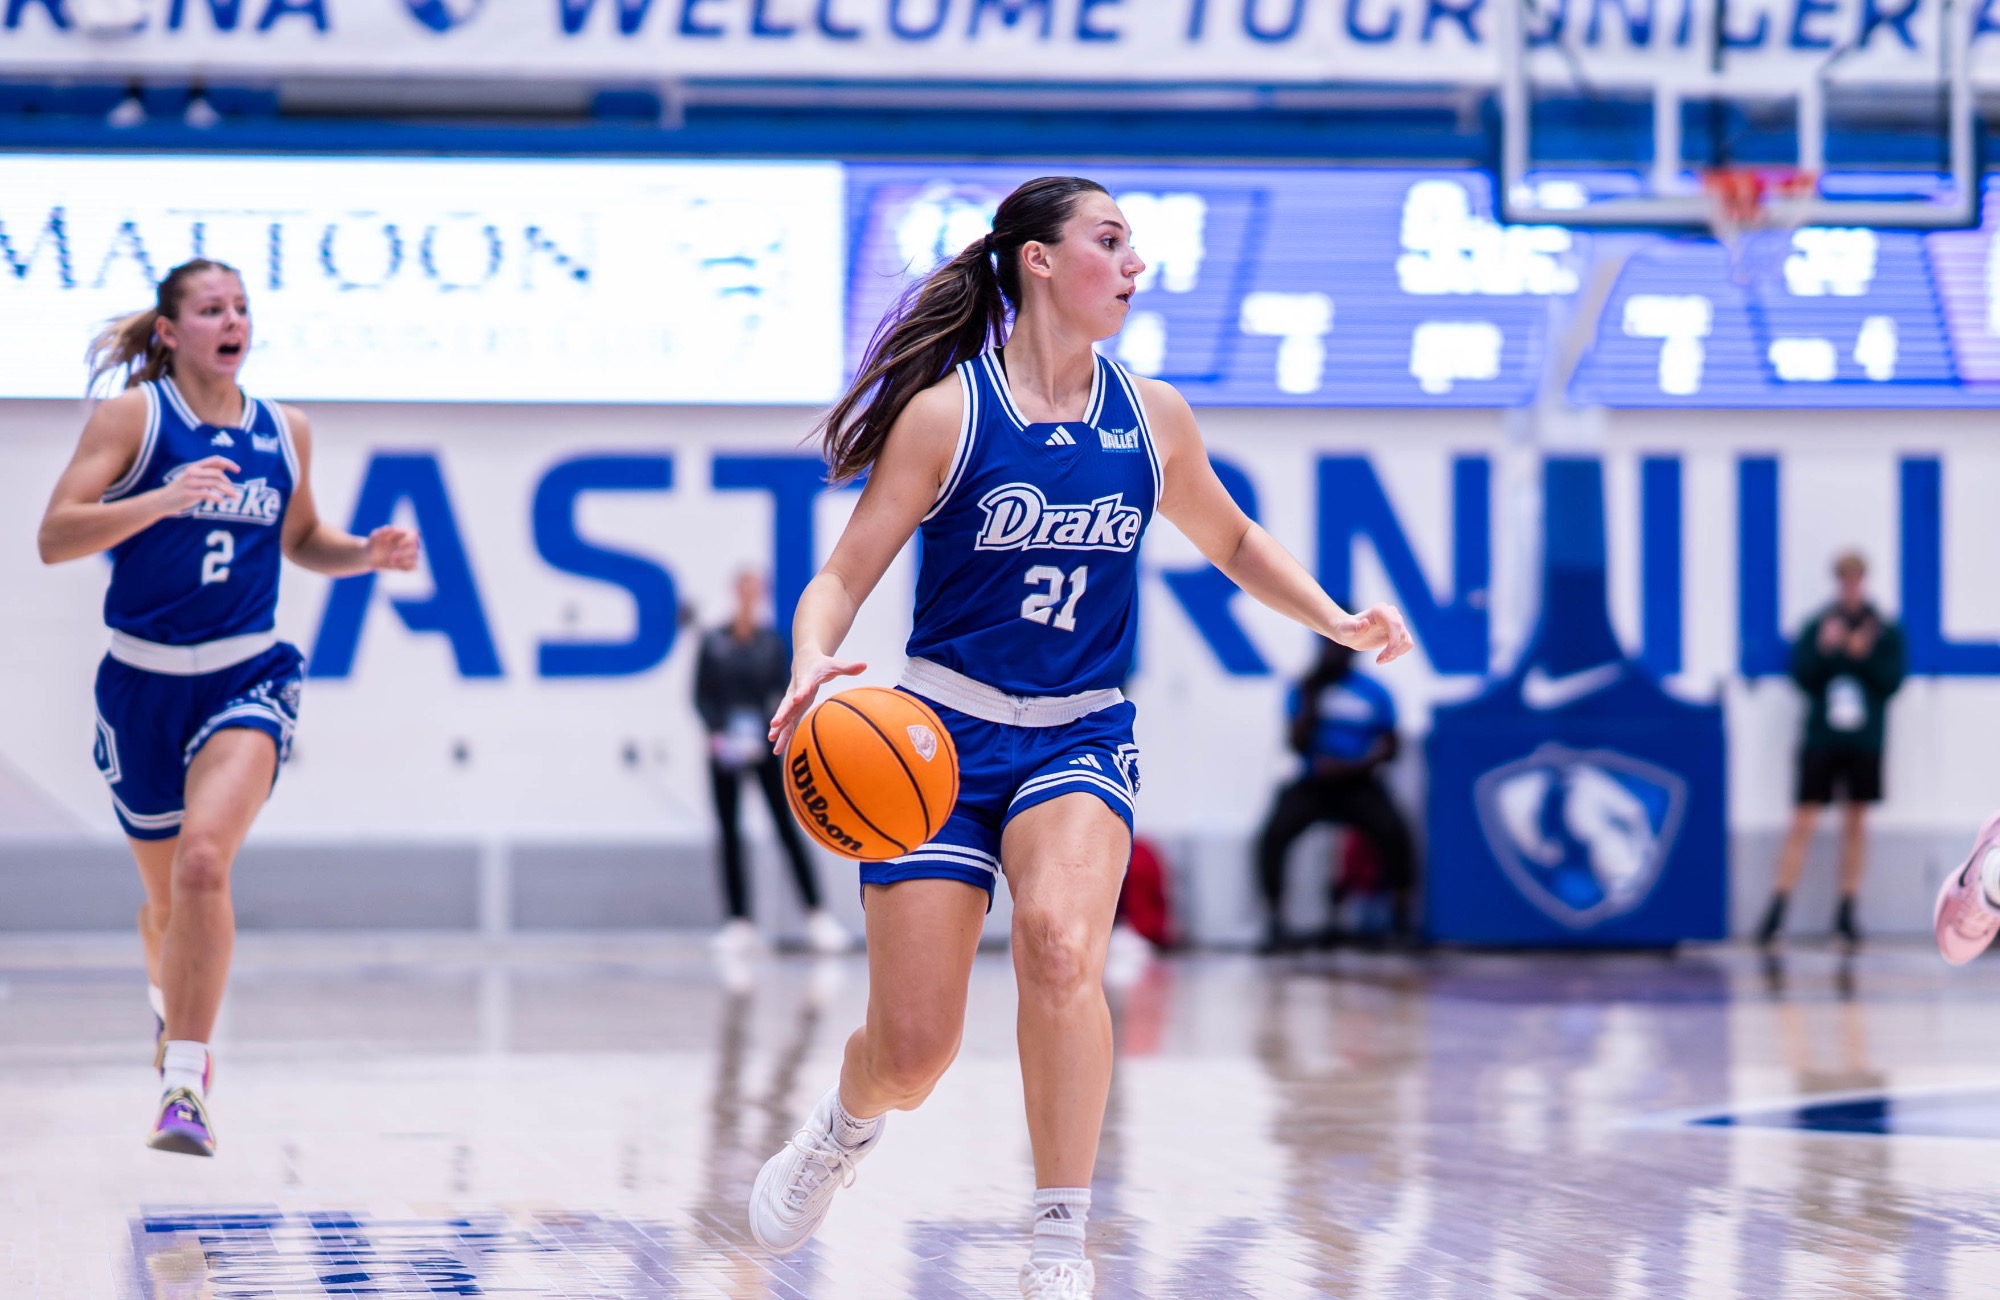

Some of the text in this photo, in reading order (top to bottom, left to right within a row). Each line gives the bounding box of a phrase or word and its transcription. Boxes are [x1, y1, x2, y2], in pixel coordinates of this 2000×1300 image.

[1097, 425, 1139, 449] VALLEY
[162, 459, 281, 526] rake
[974, 482, 1142, 552] Drake
[201, 530, 235, 585] 2
[1020, 564, 1088, 632] 21
[790, 747, 864, 853] Wilson
